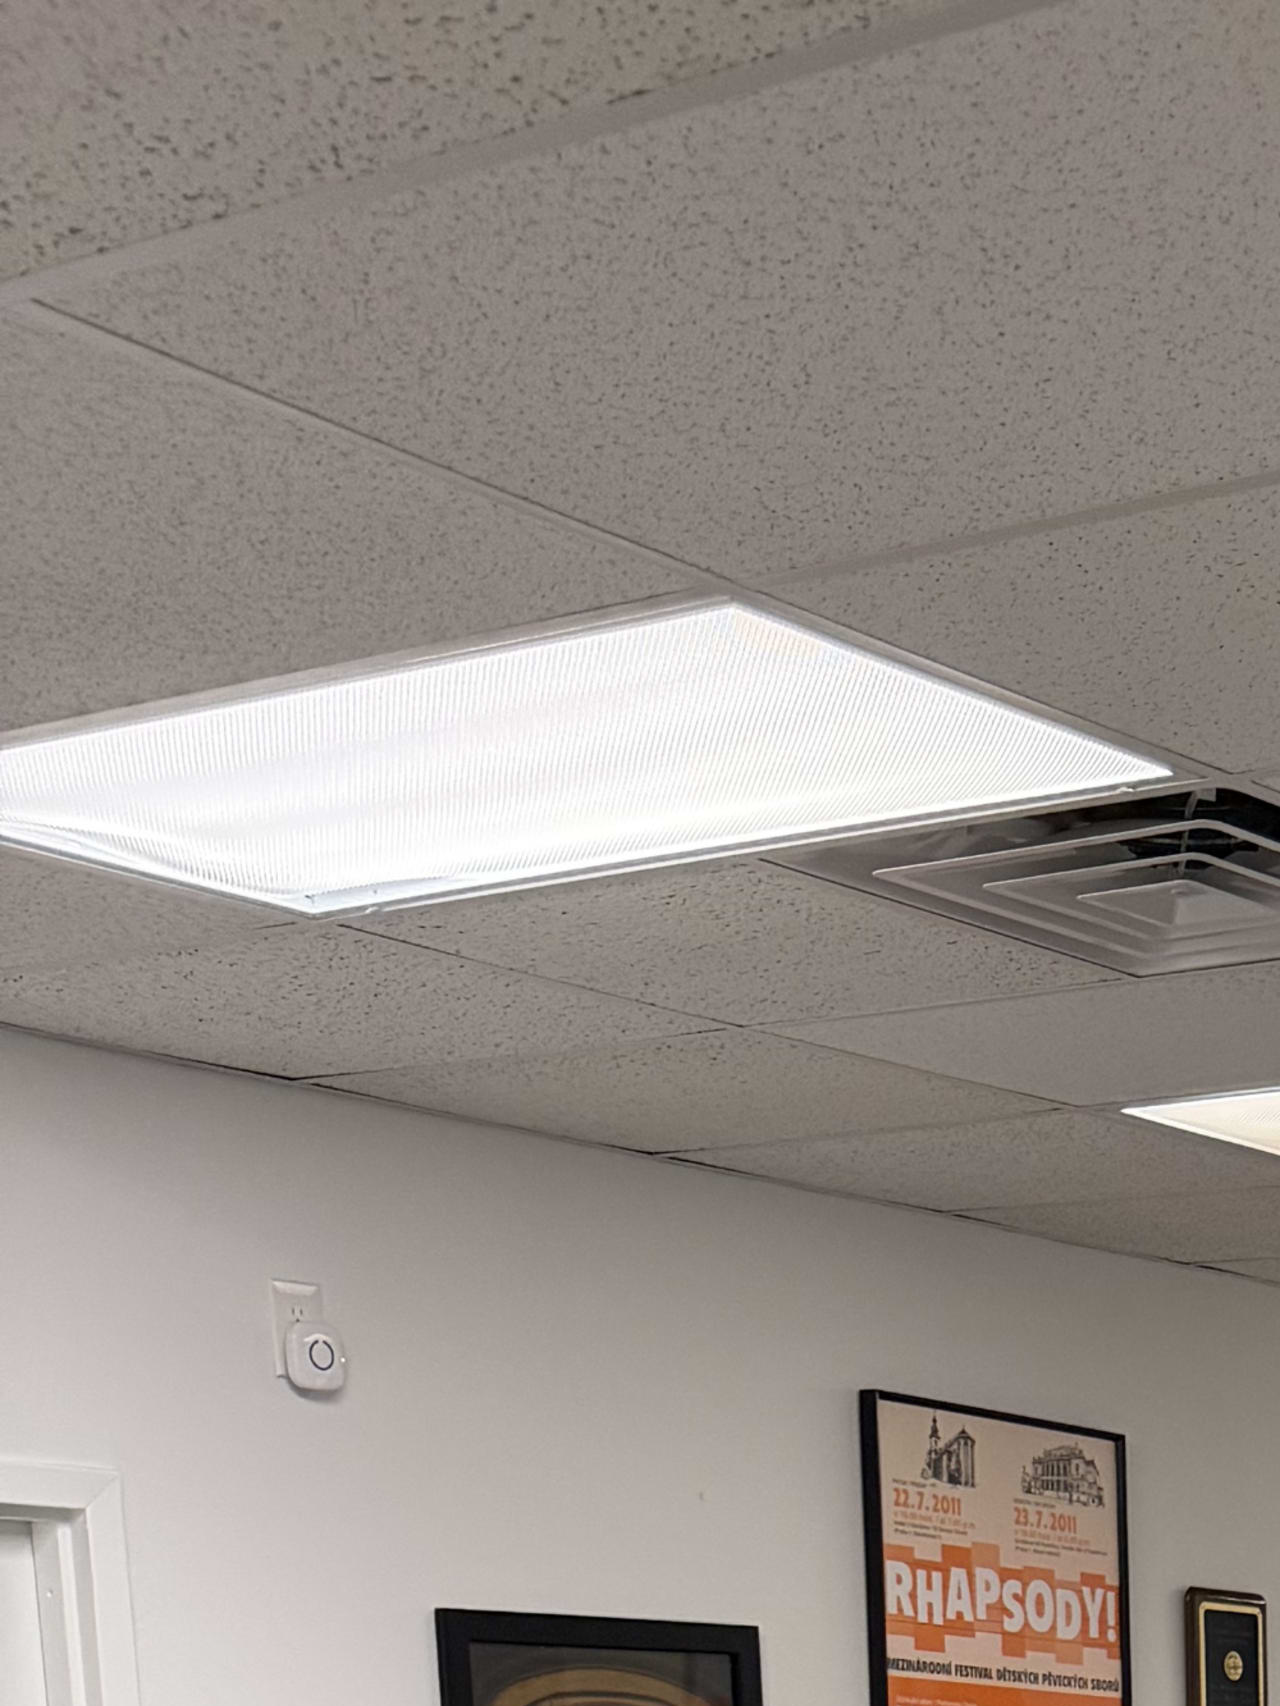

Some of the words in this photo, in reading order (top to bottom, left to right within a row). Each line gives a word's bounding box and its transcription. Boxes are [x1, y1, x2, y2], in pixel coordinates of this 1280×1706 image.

[893, 1487, 961, 1516] 22.7.2011
[1013, 1507, 1077, 1534] 23.7.2011
[886, 1559, 1118, 1643] RHAPSODY!
[954, 1664, 993, 1681] FESTIVAL
